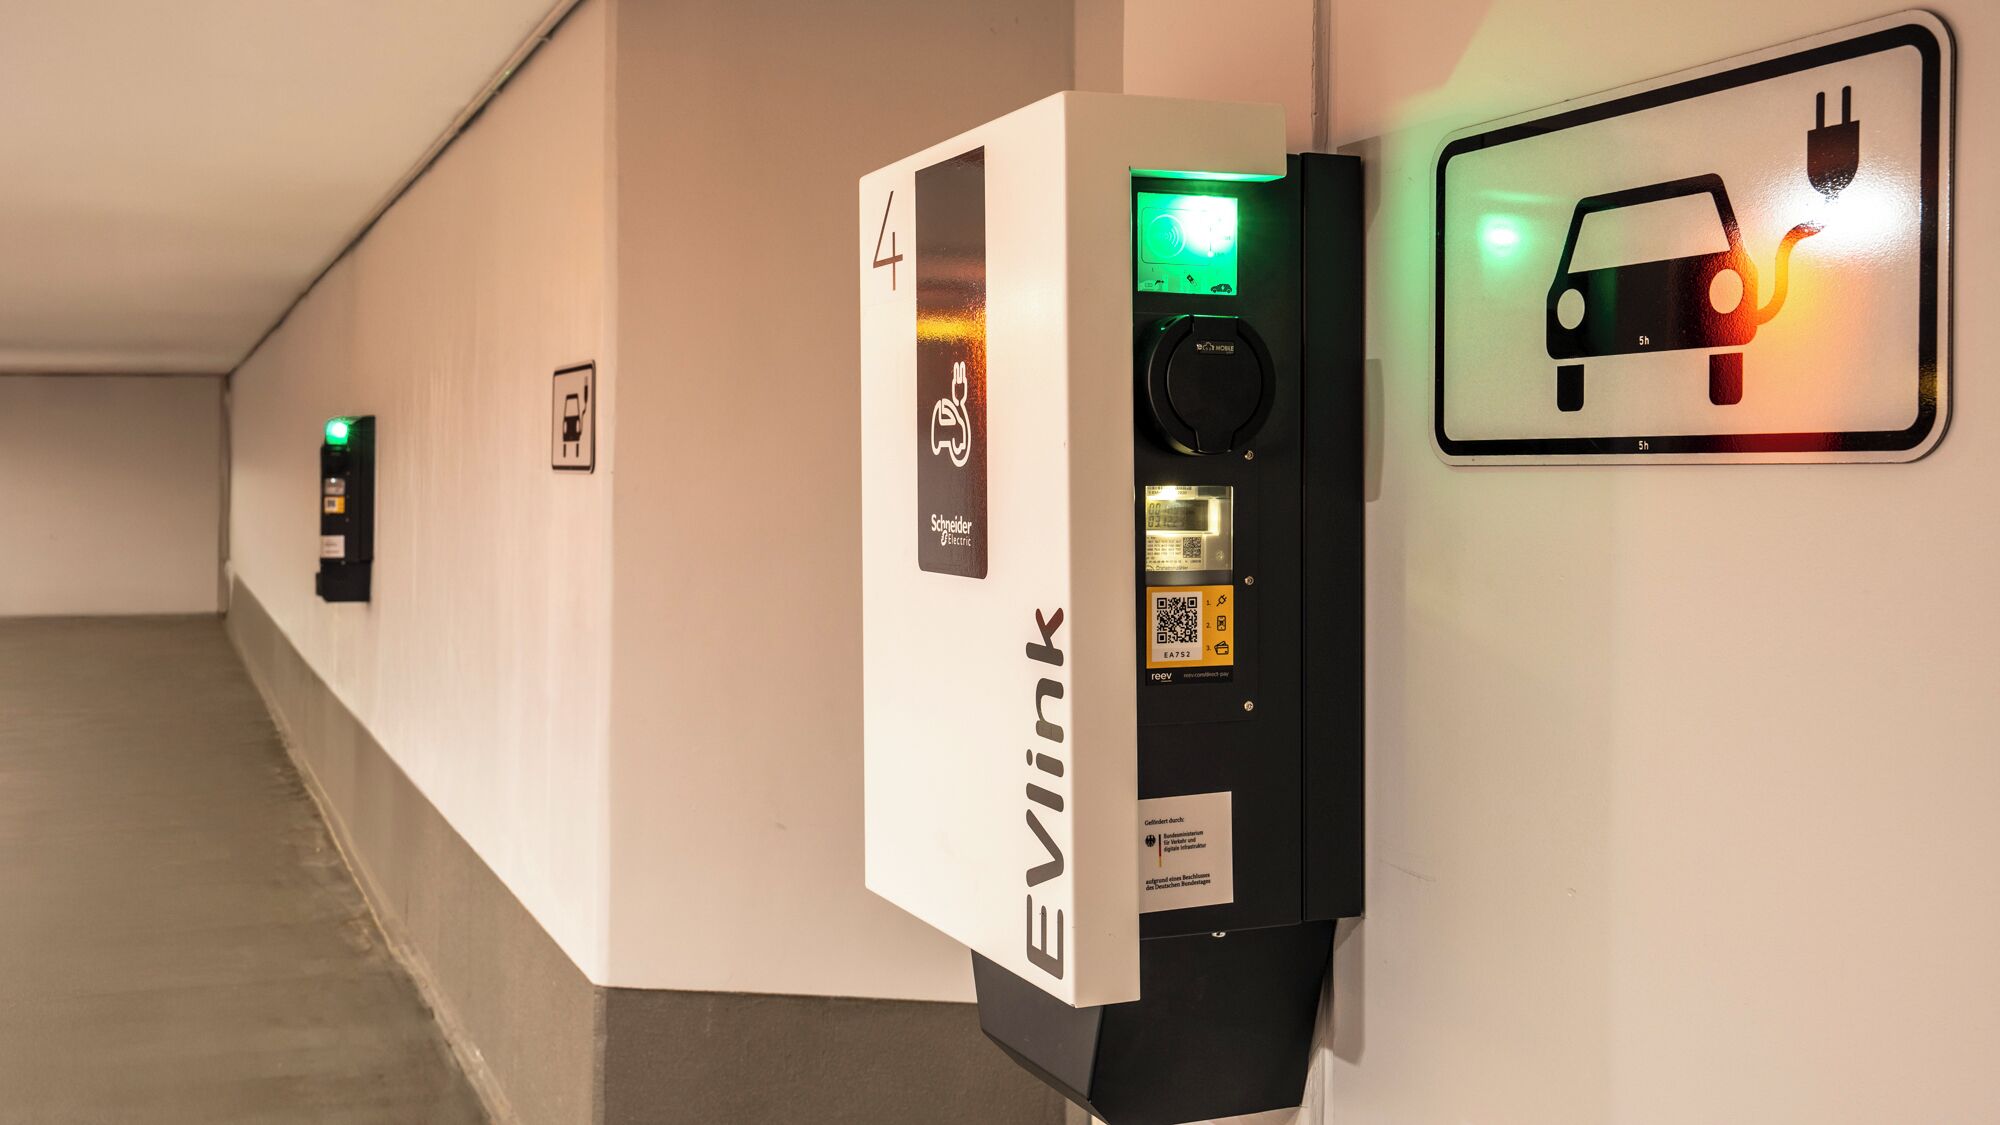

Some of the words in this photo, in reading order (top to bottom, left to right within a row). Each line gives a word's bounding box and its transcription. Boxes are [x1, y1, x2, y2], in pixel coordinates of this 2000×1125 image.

[873, 190, 903, 291] 4
[1639, 335, 1650, 346] 5h
[1638, 440, 1649, 451] 5h
[931, 513, 972, 535] Schneider
[947, 533, 971, 547] Electric
[1151, 672, 1172, 680] reev
[1025, 607, 1065, 981] EVlink
